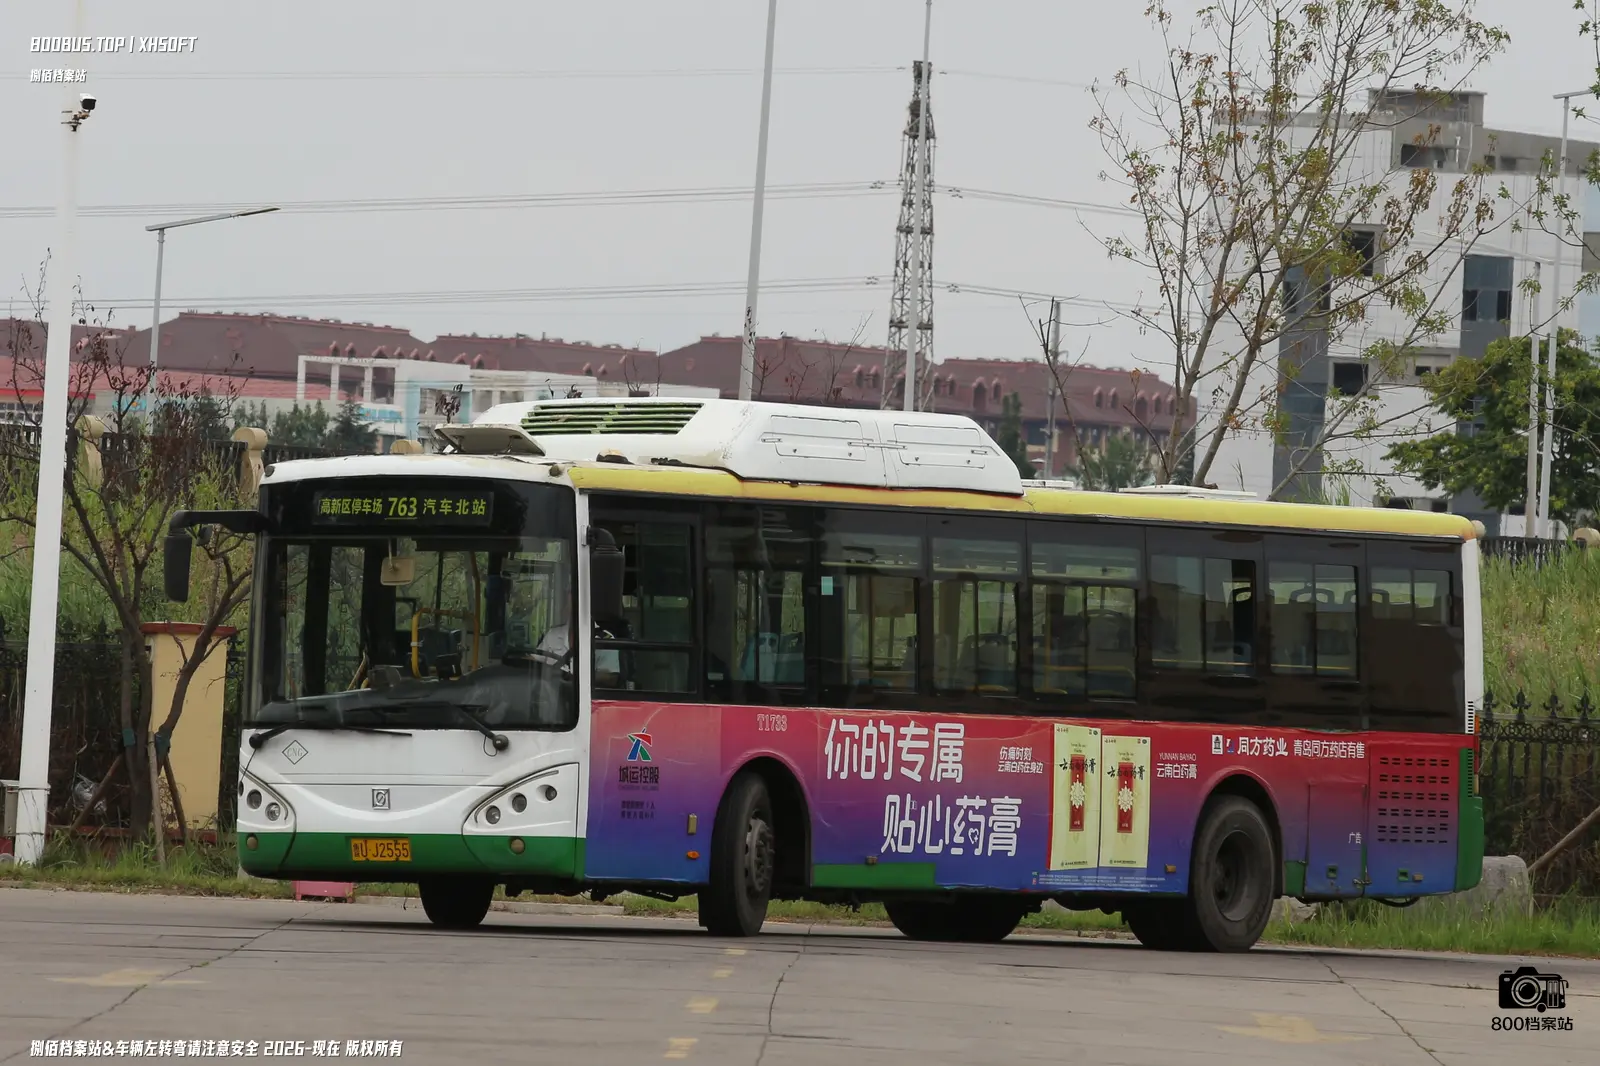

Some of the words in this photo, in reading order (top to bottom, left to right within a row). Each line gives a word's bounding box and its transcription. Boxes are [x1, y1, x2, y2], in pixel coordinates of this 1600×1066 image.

[320, 497, 383, 515] 高新区停车场
[388, 497, 418, 517] 763
[422, 498, 487, 516] 汽车北站
[286, 747, 304, 758] CNG
[824, 717, 966, 783] 你的专属
[999, 746, 1033, 761] 伤痛时刻
[1158, 752, 1179, 761] YUNNAN
[1237, 736, 1289, 757] 同方药业
[1293, 739, 1366, 759] 青岛同方药店有售
[618, 765, 660, 785] 城运控股
[997, 760, 1044, 774] 云南白药在身边
[1156, 762, 1198, 780] 云南白药膏
[880, 793, 1023, 857] 贴心药膏
[1347, 832, 1362, 845] 广告
